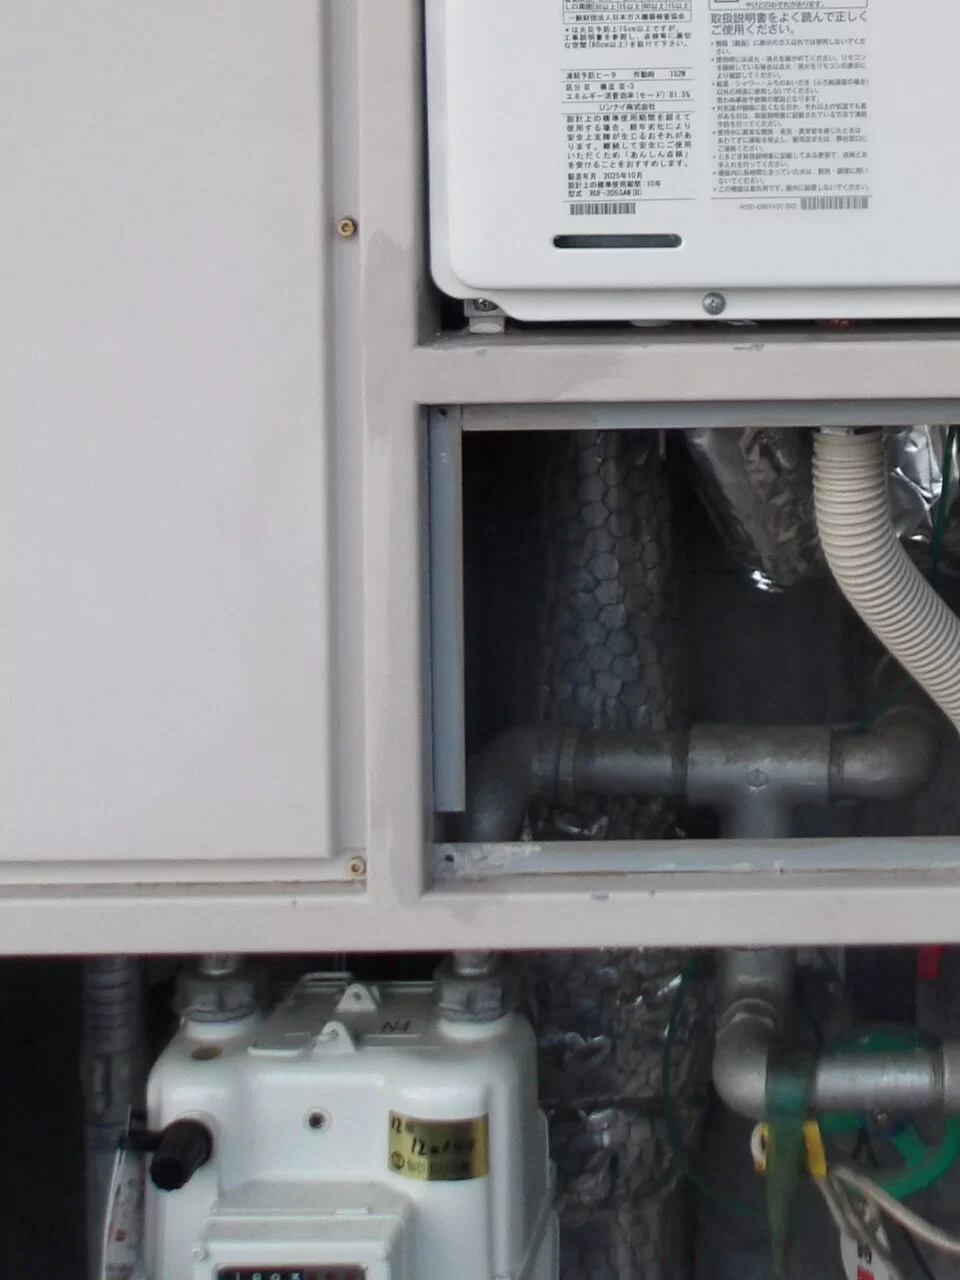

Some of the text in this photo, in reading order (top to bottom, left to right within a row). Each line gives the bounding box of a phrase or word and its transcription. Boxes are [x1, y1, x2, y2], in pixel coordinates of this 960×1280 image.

[711, 11, 867, 25] 取扱説明書をよく読んで正しく
[711, 23, 795, 36] ご使用ください。
